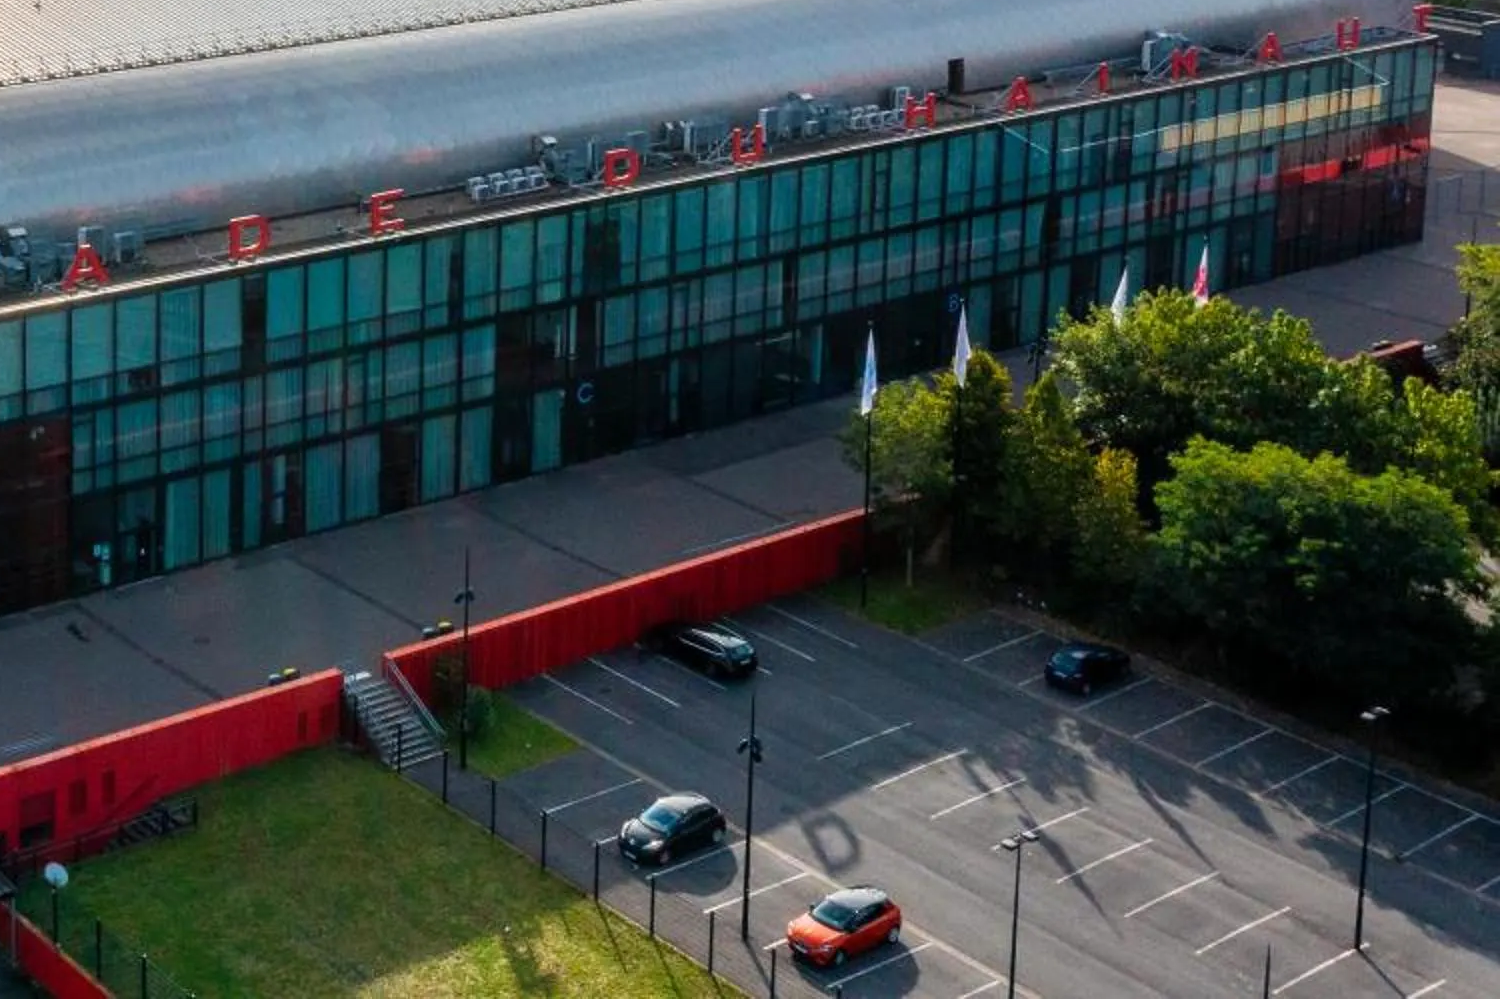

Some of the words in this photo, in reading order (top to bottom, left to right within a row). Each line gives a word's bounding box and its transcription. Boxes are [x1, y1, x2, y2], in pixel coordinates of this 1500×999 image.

[604, 123, 763, 188] DU
[905, 3, 1434, 130] HAINAUT
[576, 381, 595, 403] C
